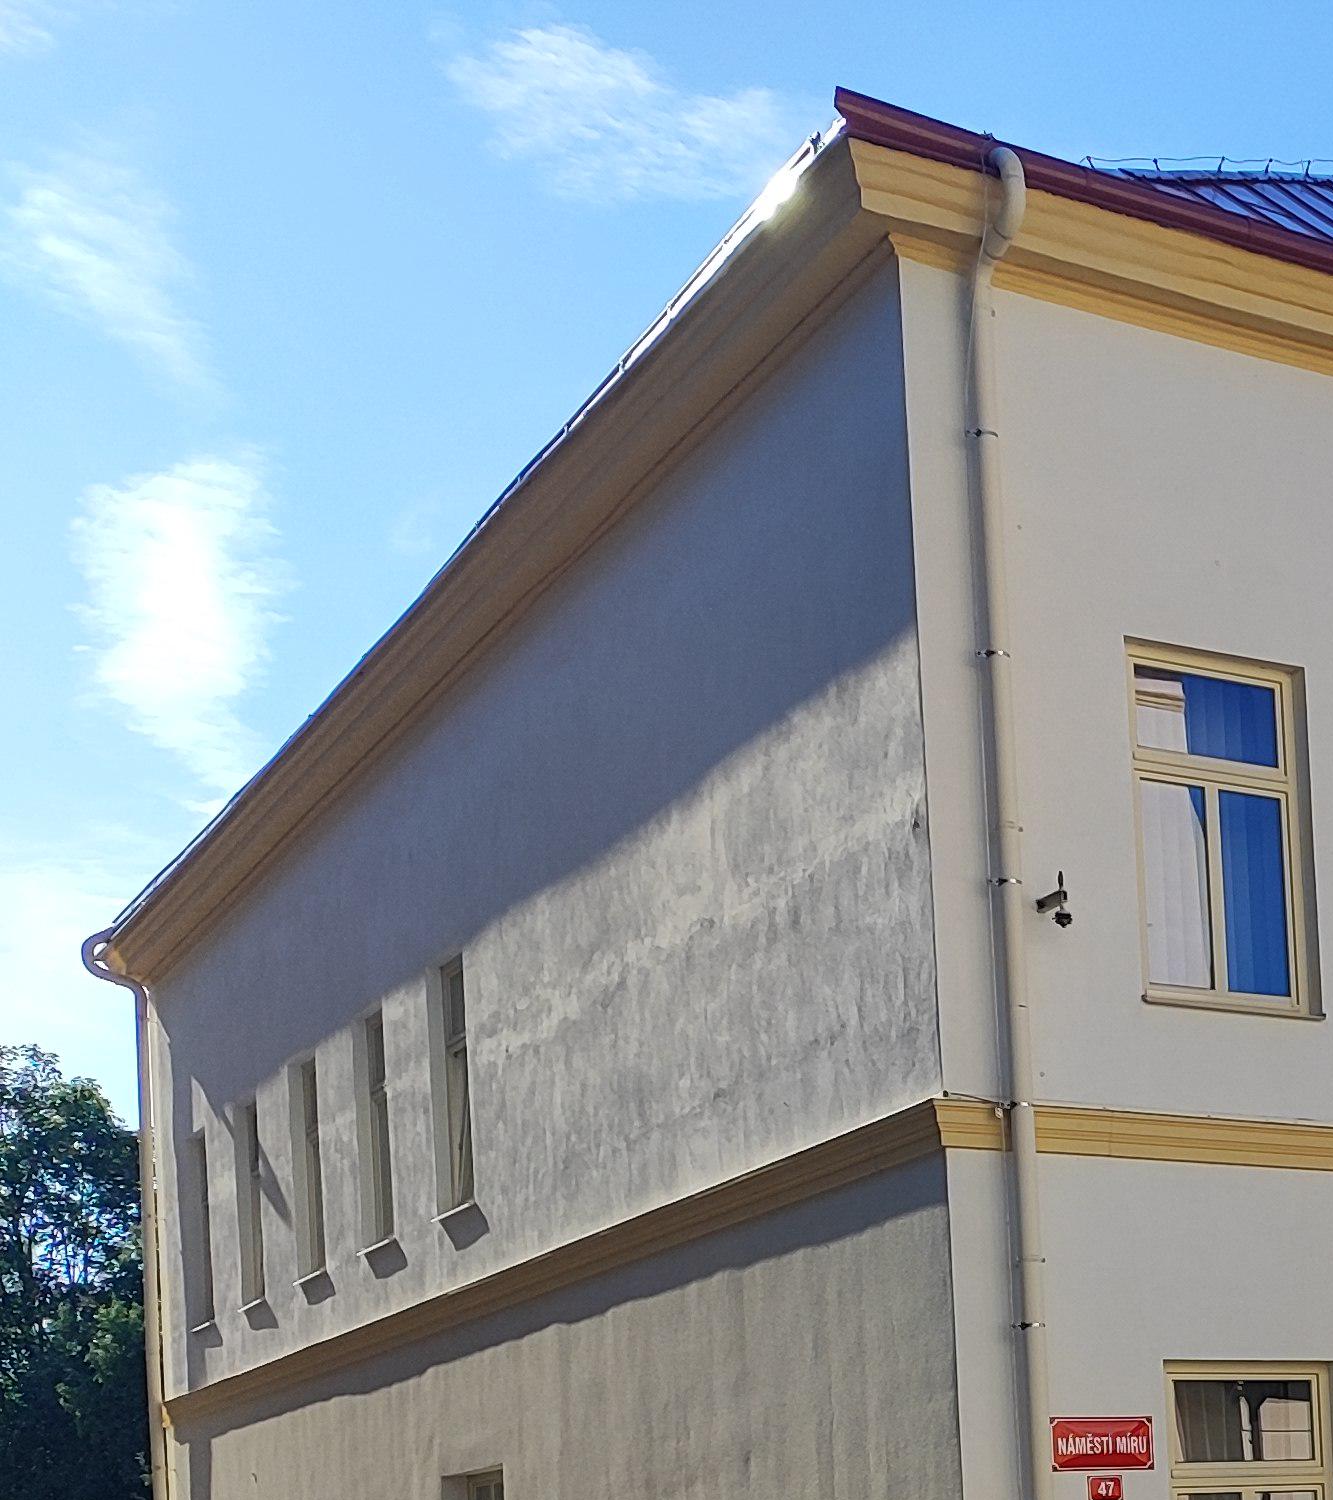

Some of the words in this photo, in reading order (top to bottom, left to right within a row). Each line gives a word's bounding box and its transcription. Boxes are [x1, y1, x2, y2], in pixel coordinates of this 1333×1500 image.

[1057, 1433, 1113, 1456] NÁMĚSTÍ
[1116, 1433, 1148, 1455] MÍRU
[1097, 1481, 1115, 1497] 47
